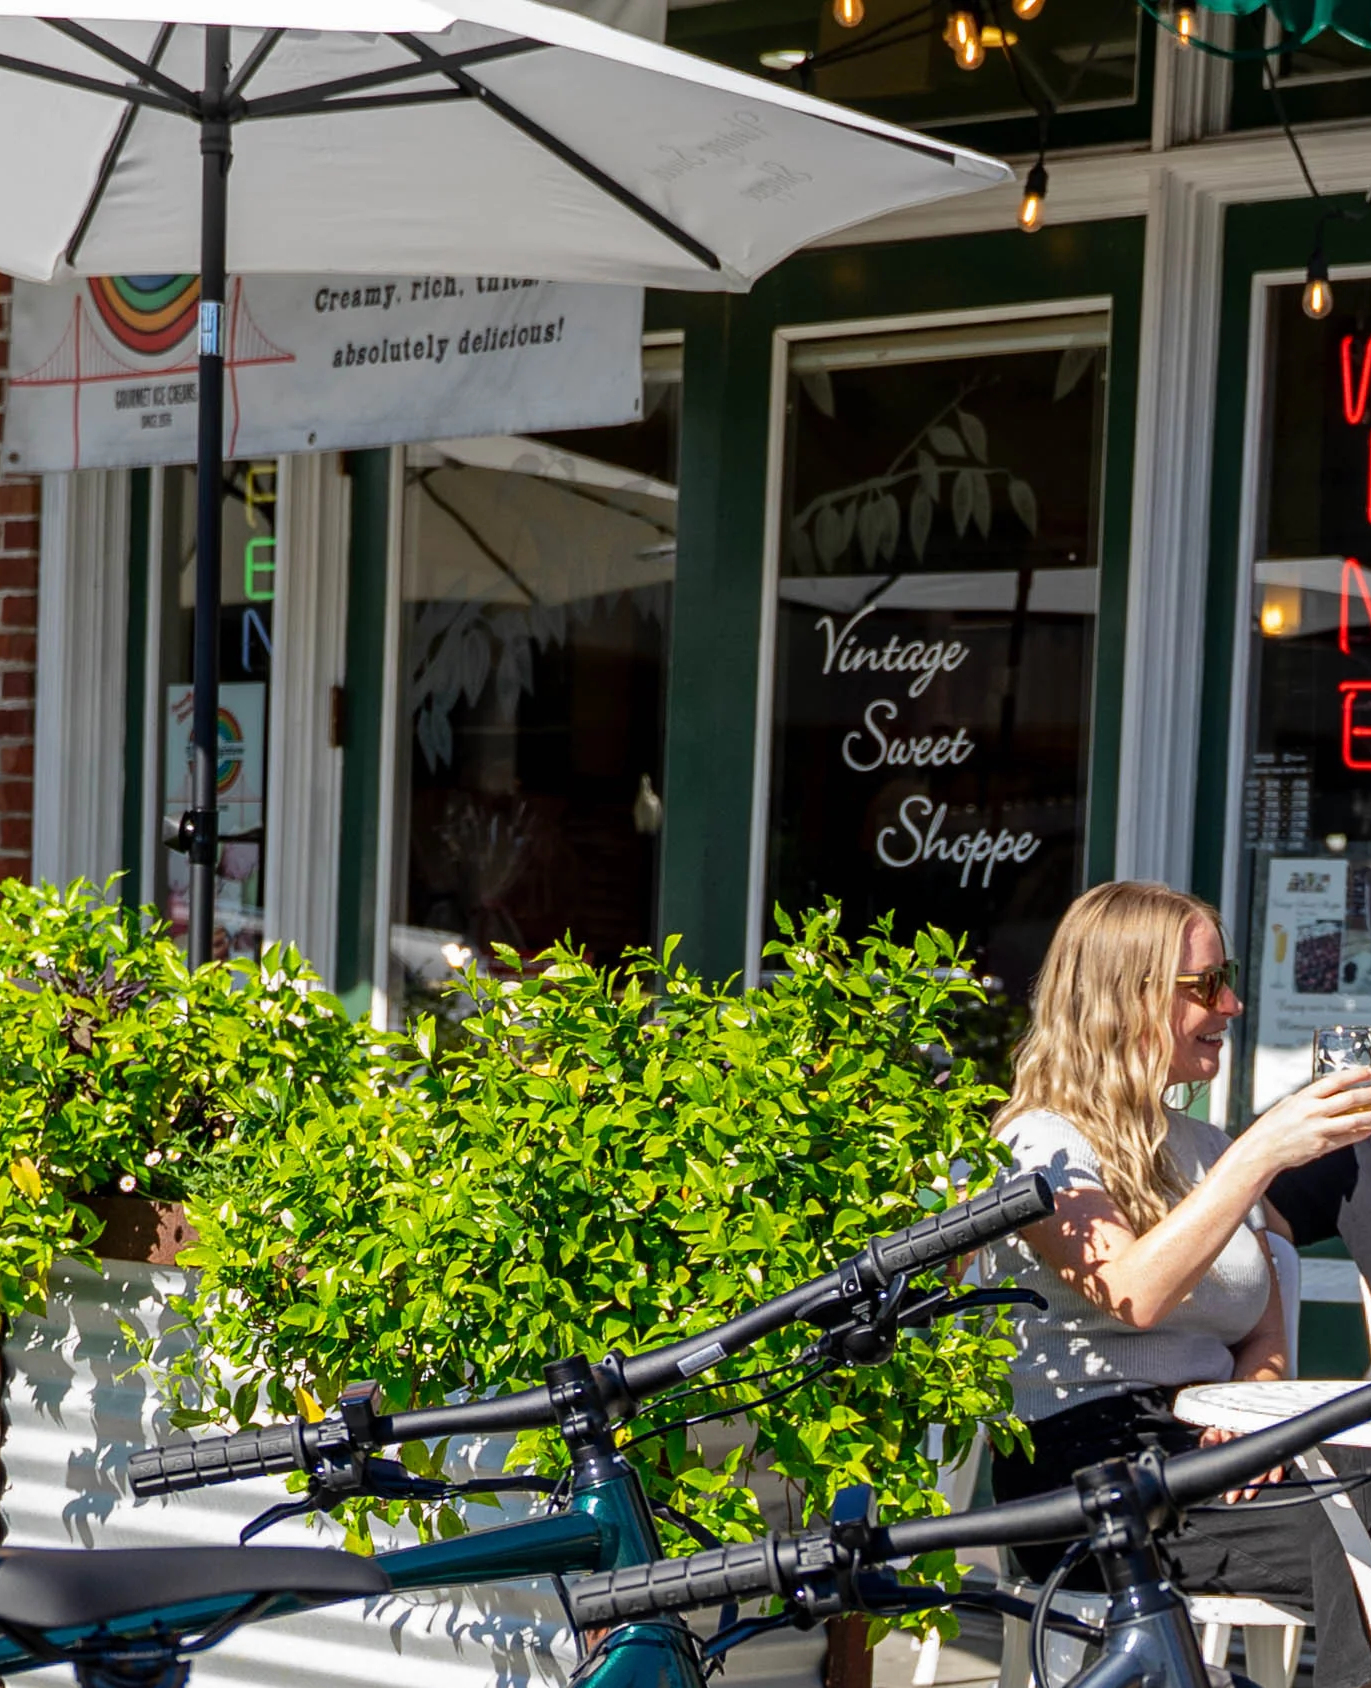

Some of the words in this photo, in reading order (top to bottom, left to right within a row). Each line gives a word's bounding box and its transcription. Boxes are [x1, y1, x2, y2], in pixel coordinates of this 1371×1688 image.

[315, 281, 402, 313] Creamy,
[410, 275, 465, 301] rich,
[332, 334, 449, 369] absolutely
[458, 316, 566, 355] delicious!
[241, 464, 277, 673] PEN
[816, 605, 969, 698] Vintage
[842, 699, 974, 772] Sweet
[876, 795, 1041, 889] Shoppe
